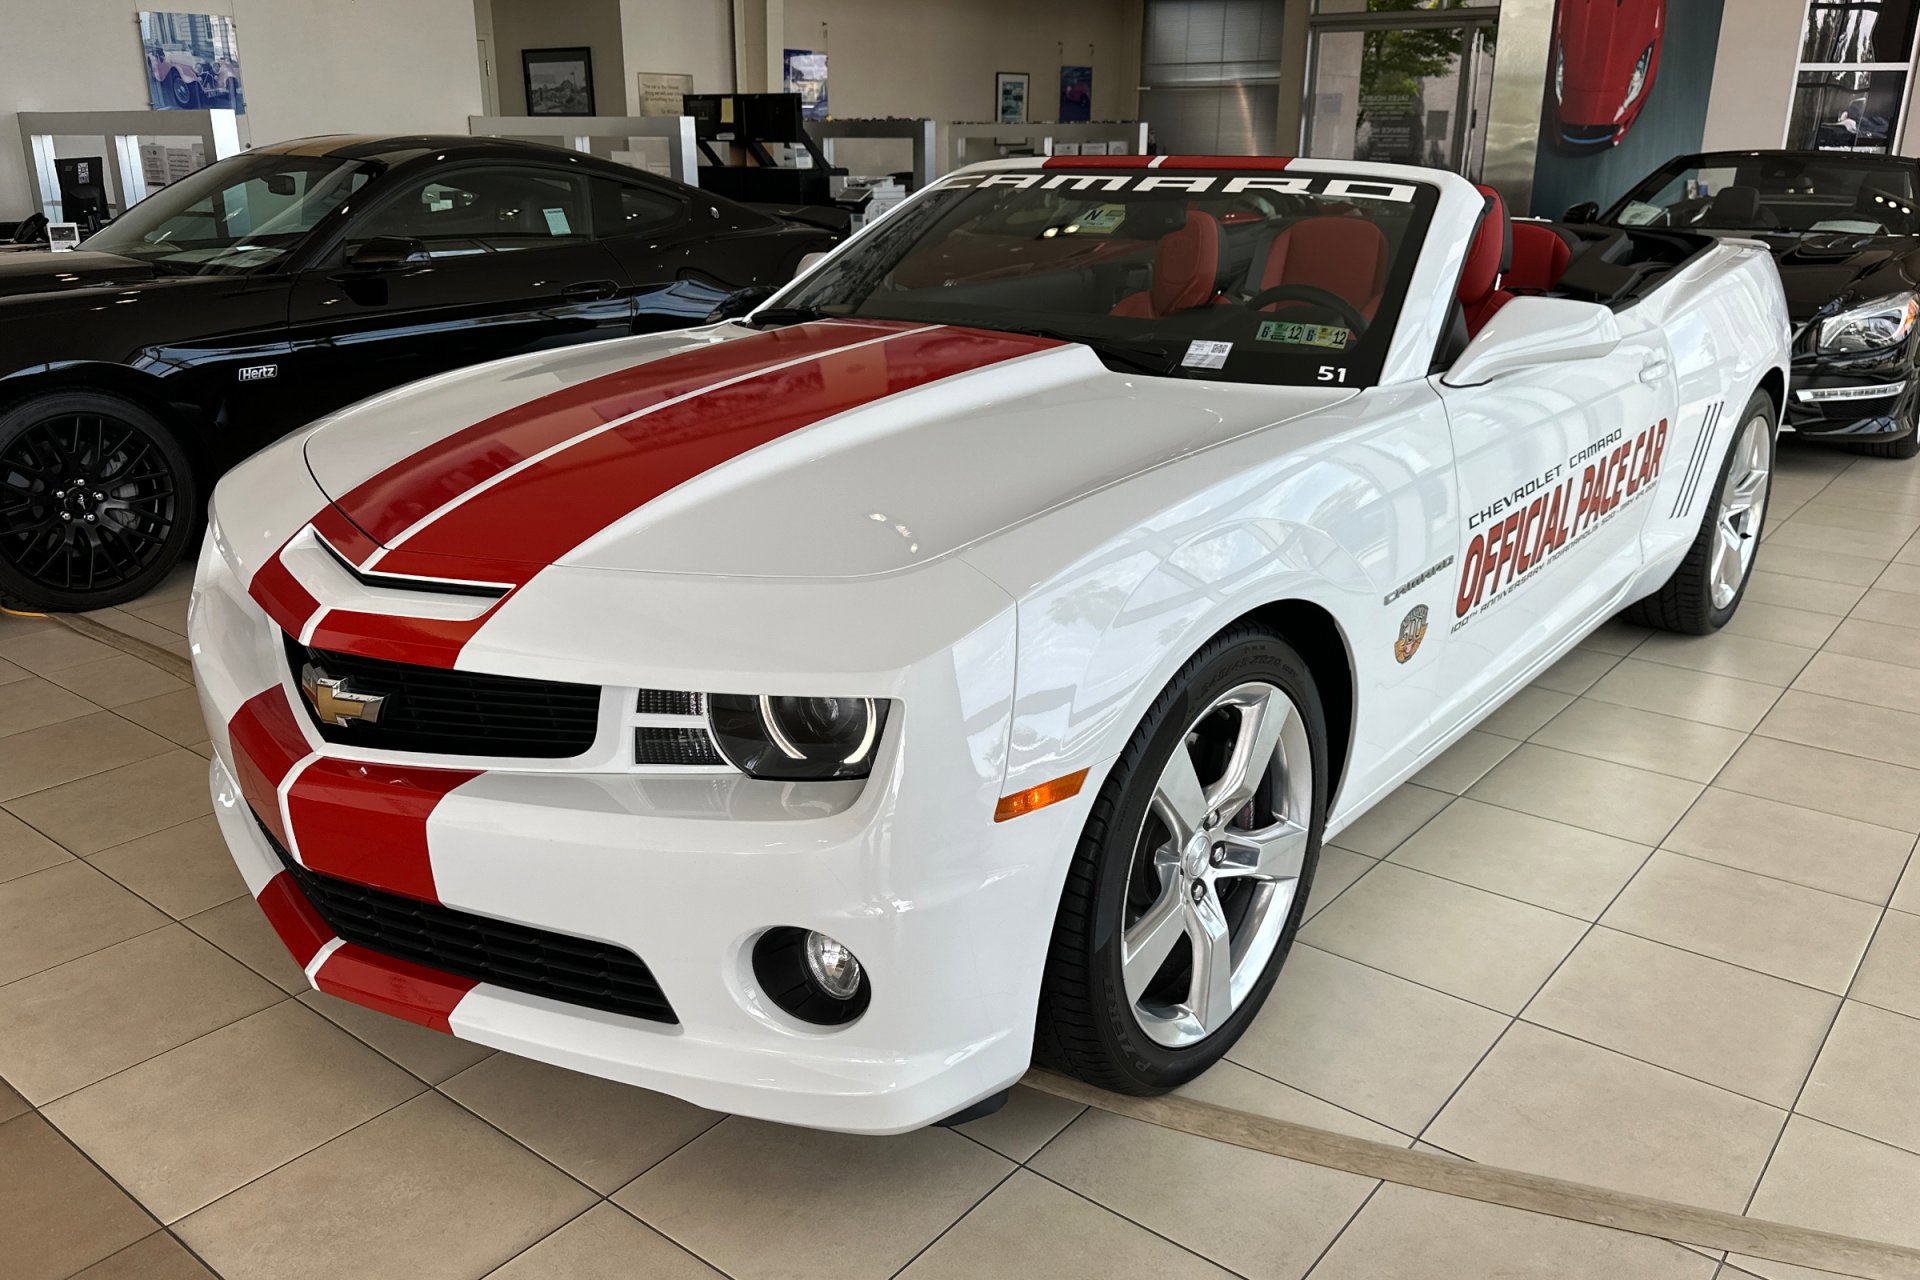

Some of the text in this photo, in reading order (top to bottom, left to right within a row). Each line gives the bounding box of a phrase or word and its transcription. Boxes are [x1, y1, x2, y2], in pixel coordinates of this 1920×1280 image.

[933, 174, 1417, 203] CAMARO
[1084, 209, 1104, 221] N
[1287, 326, 1303, 340] 12
[1332, 330, 1347, 345] 12
[243, 366, 275, 380] Hertz
[1317, 365, 1347, 383] 51
[1468, 427, 1623, 530] CHEVROLET CAMARO
[1455, 417, 1668, 619] OFFICIAL PACE CAR
[1479, 563, 1545, 614] ANNIVERSARY
